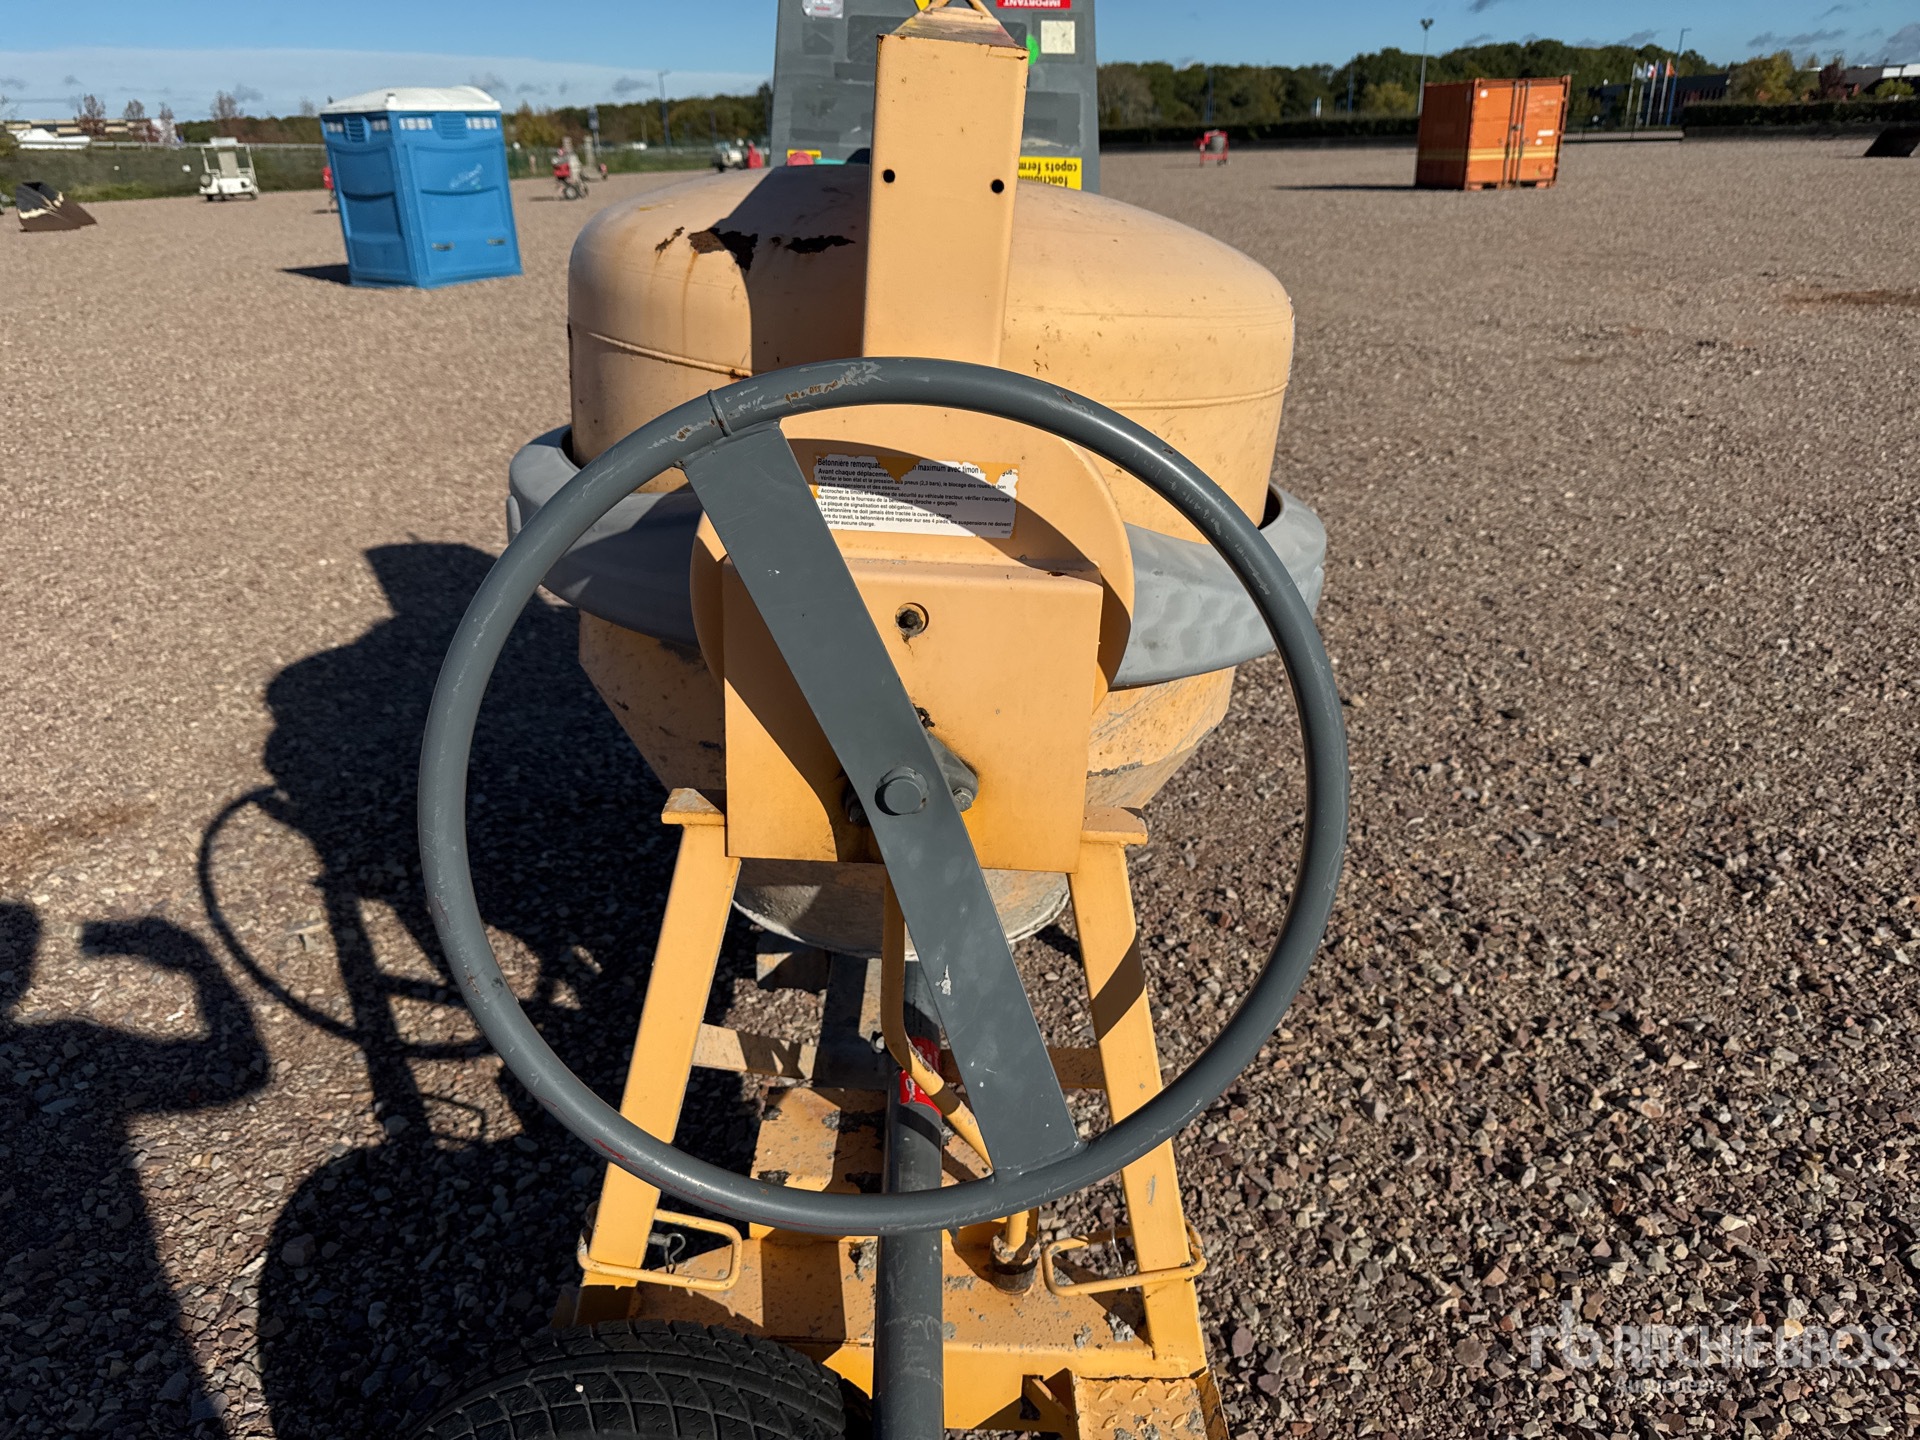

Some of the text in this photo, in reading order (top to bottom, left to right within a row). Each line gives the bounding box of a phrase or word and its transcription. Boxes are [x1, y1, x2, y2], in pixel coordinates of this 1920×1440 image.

[1018, 160, 1077, 174] capots ferm
[817, 457, 849, 467] Bétonnière
[918, 464, 946, 473] maximum
[962, 465, 979, 474] timon
[948, 481, 967, 489] blocage
[981, 495, 1011, 503] l'accrochage
